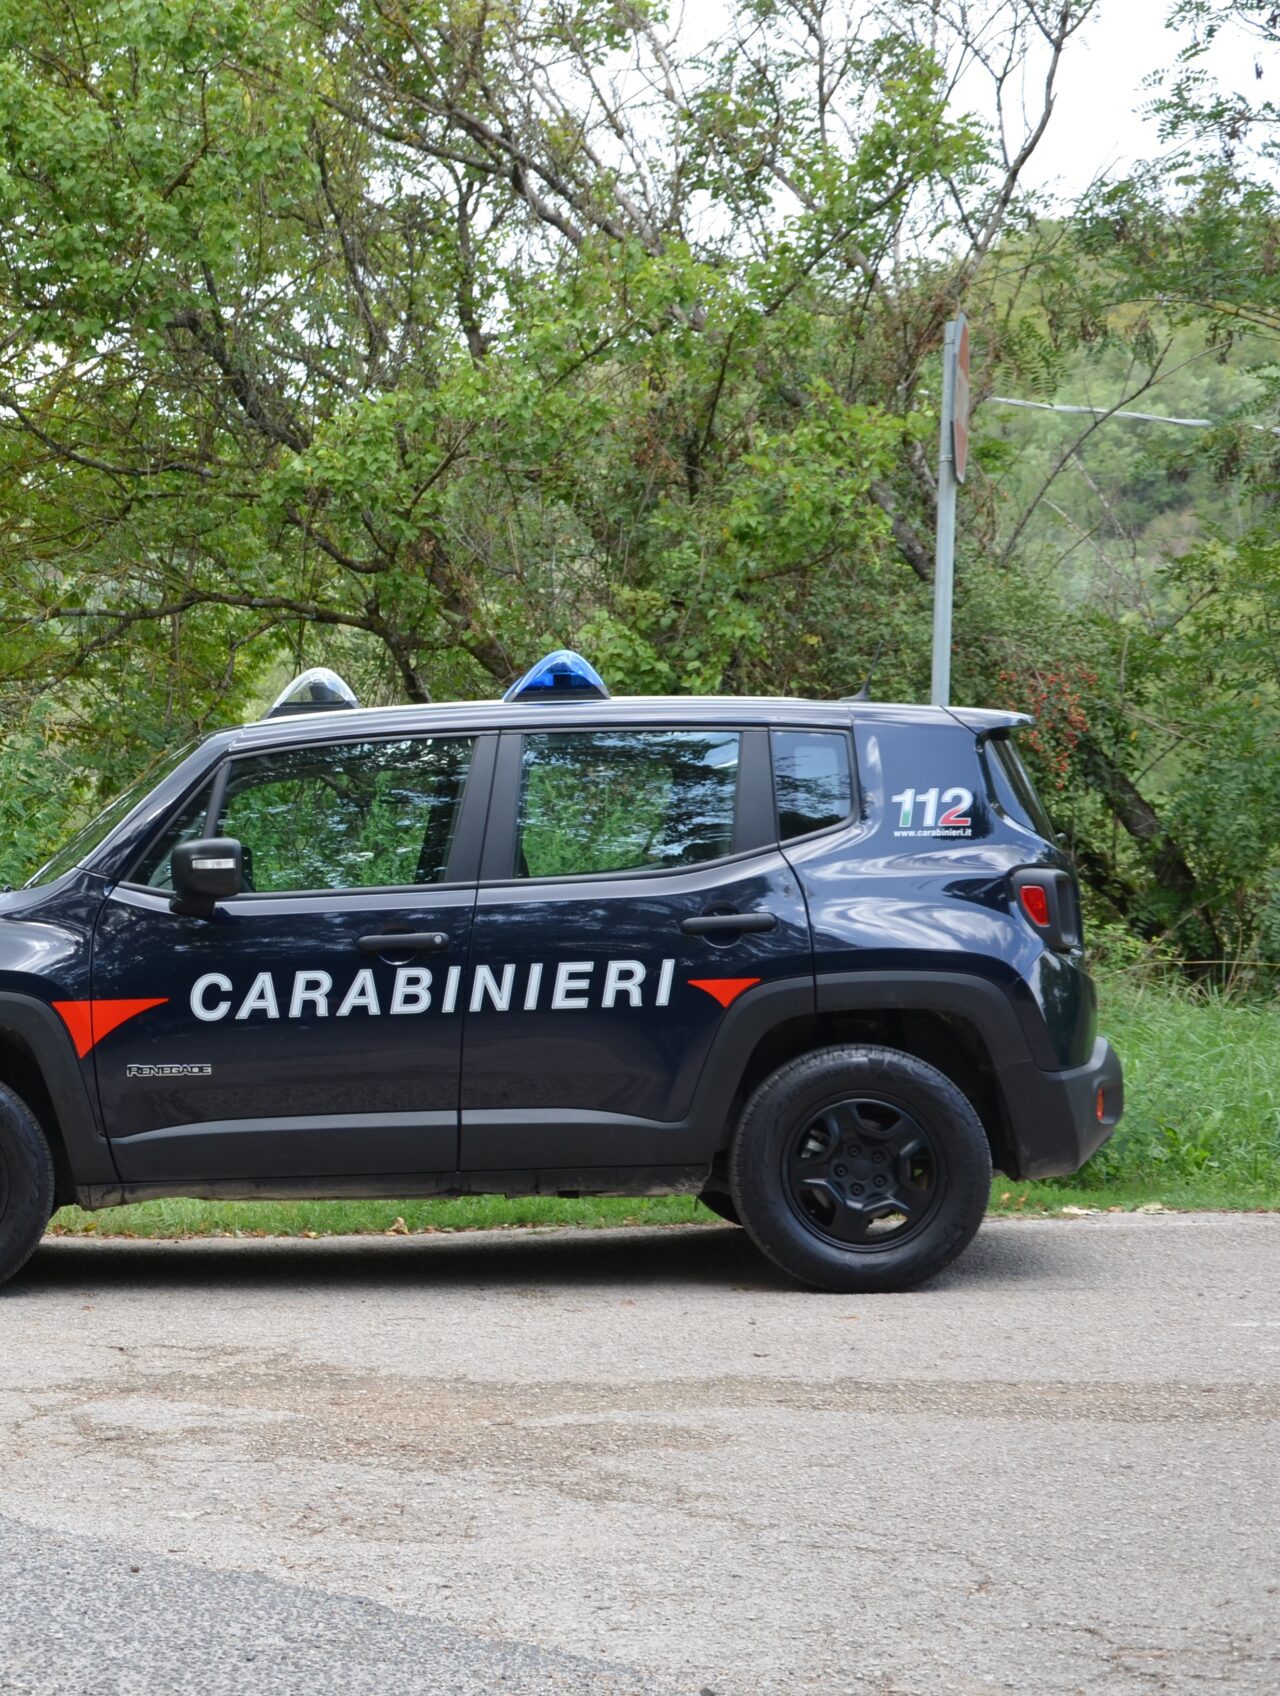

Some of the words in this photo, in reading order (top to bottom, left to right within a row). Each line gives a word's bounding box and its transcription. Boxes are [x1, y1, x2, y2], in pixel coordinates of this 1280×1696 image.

[891, 787, 974, 828] 112
[893, 828, 972, 838] www.carabinieri.it
[190, 958, 676, 1022] CARABINIERI
[127, 1064, 211, 1077] RENEGADE
